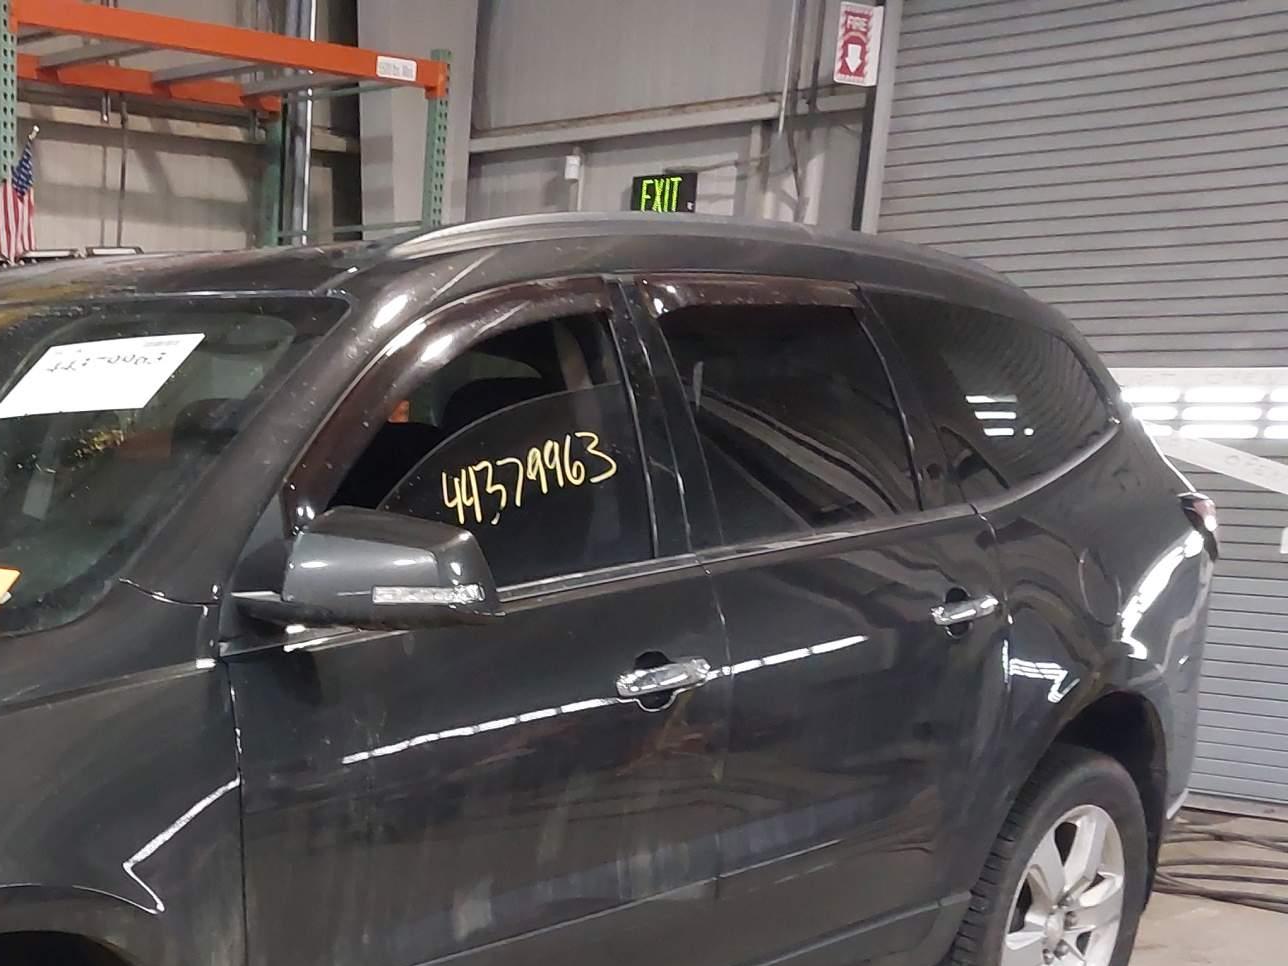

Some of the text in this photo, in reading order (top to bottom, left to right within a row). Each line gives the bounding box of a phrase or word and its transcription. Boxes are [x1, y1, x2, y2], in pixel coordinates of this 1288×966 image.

[847, 16, 868, 32] FIRE
[640, 176, 683, 213] EXIT
[441, 431, 617, 526] 44379963
